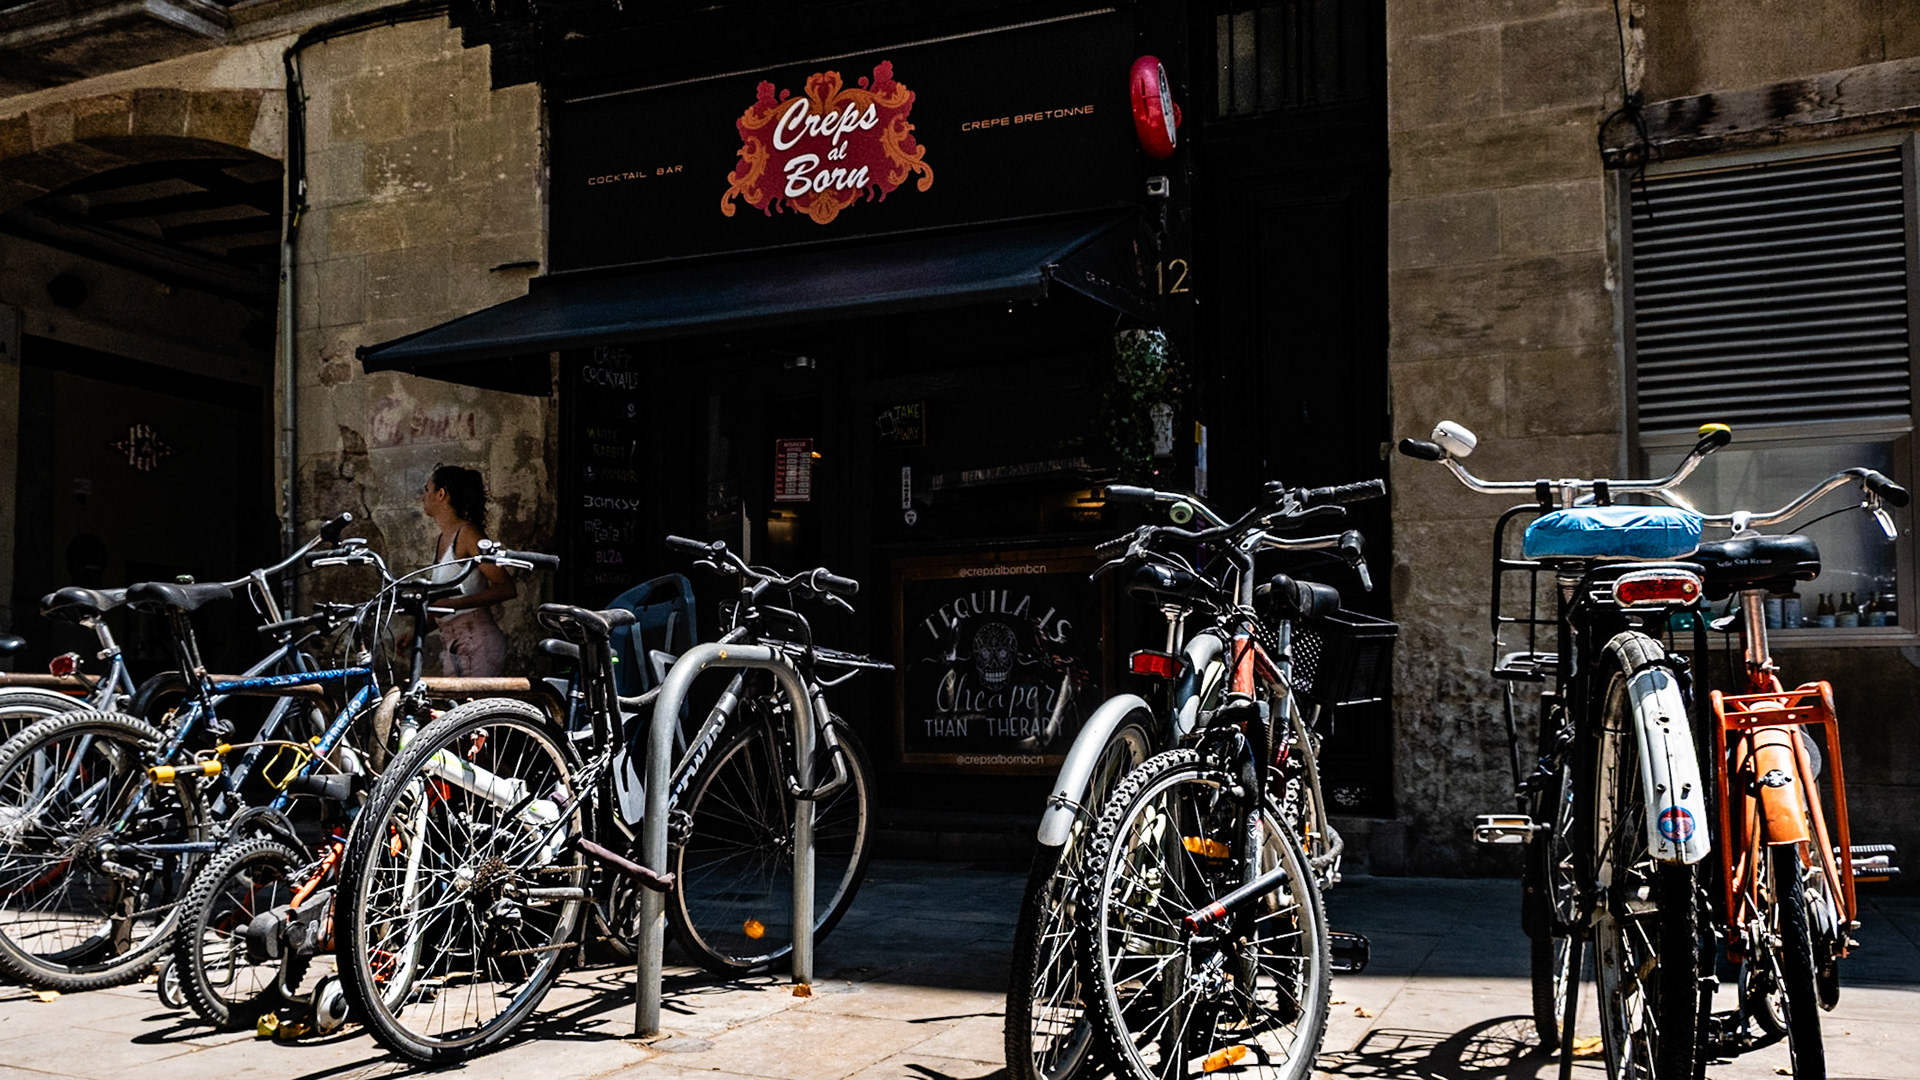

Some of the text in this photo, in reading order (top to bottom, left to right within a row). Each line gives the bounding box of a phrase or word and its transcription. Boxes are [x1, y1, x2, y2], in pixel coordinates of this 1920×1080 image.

[772, 98, 880, 151] Creps
[1014, 104, 1094, 124] BRETONNE
[827, 140, 848, 162] al
[588, 165, 683, 186] COCKTAIL BAR
[784, 153, 870, 198] Born
[1155, 258, 1190, 296] 12
[594, 346, 632, 368] CRAFT
[582, 365, 639, 390] COCKTAILS
[893, 403, 921, 419] TAKE
[959, 564, 1047, 578] @crepsalbornbcn
[920, 590, 1031, 640] TEQUILA
[936, 668, 1056, 718] Cheaper
[924, 718, 968, 737] THAN
[956, 754, 1044, 765] @crepsalbornbcn
